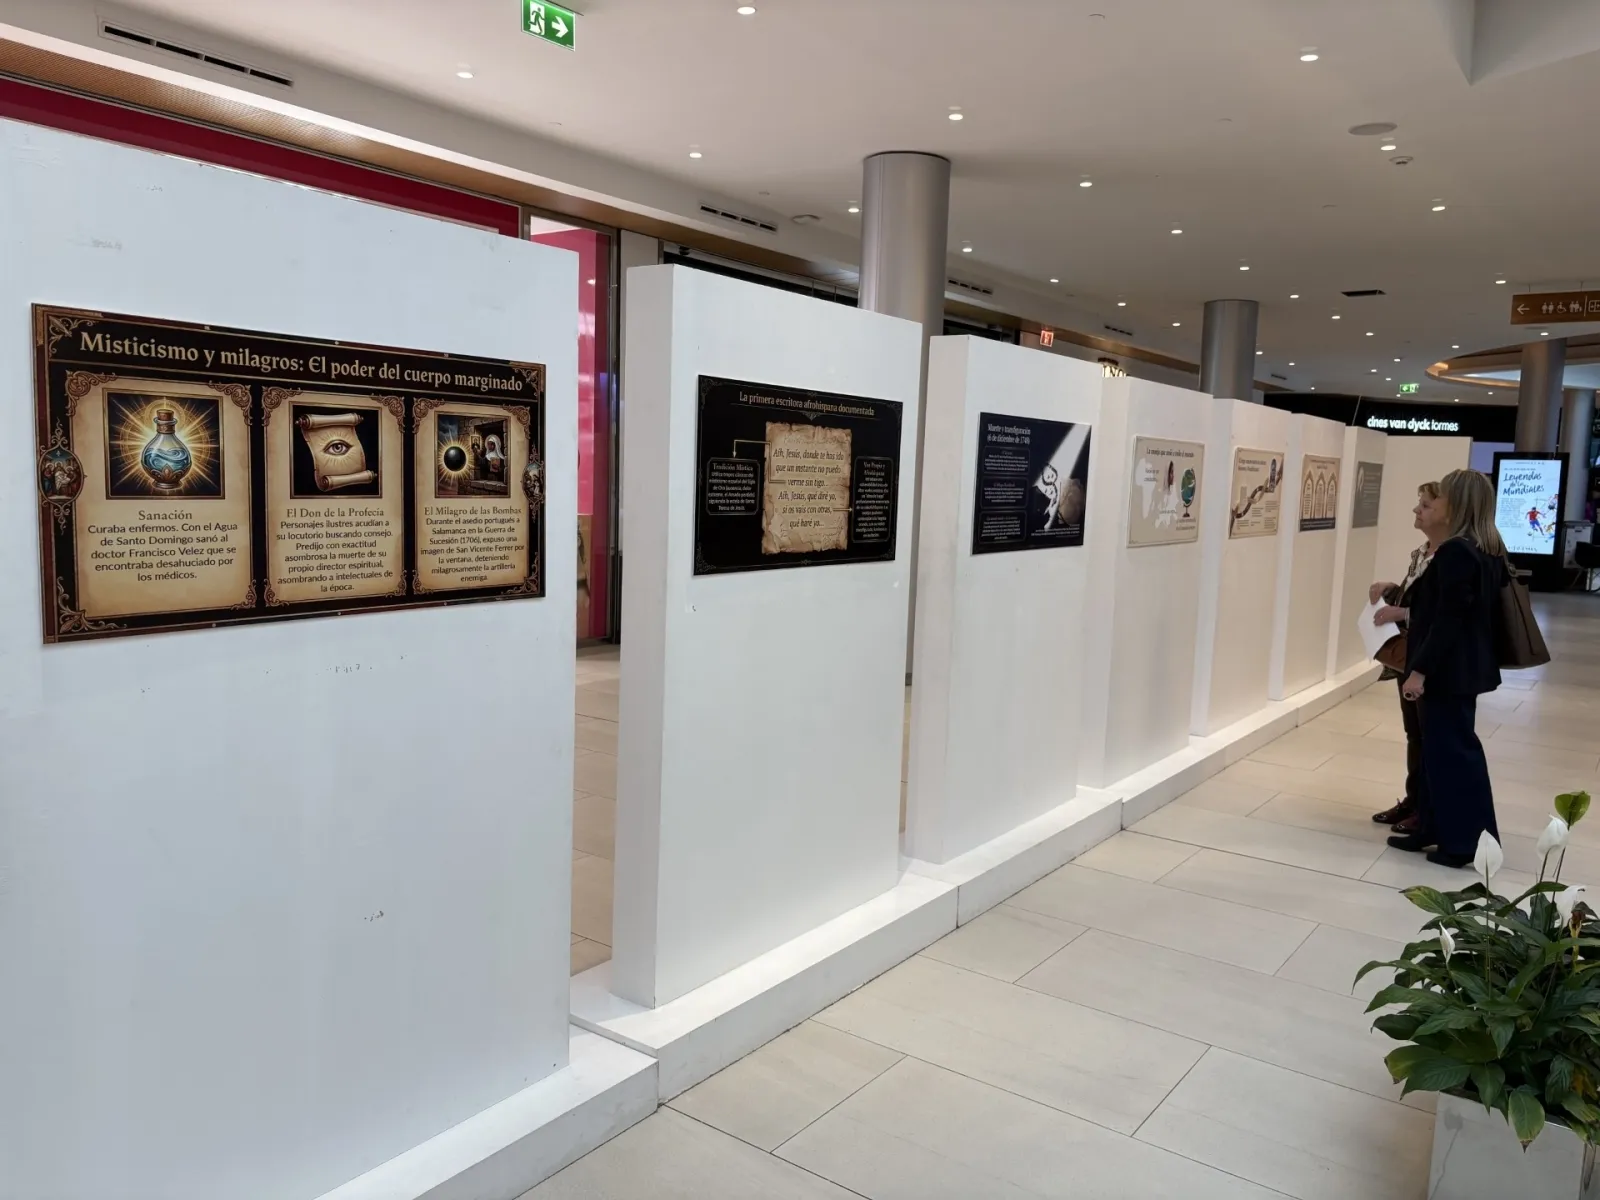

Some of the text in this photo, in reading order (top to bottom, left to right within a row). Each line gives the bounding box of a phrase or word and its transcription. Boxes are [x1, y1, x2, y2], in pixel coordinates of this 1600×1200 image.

[79, 331, 524, 391] Misticismo y milagros: El poder del cuerpo marginado
[739, 391, 874, 416] La primera escritora afrohispana documentada
[1367, 416, 1388, 428] cines
[1389, 419, 1406, 429] van
[1408, 418, 1430, 432] dyck
[776, 465, 786, 473] que
[826, 465, 841, 475] puedo
[805, 478, 813, 486] sin
[1503, 471, 1542, 483] Leyendas
[1503, 484, 1544, 496] Mundiales
[138, 509, 193, 521] Sanación
[286, 507, 384, 518] El Don de la Profecía
[424, 507, 433, 515] El
[435, 507, 468, 517] Milagro
[280, 520, 324, 530] Personajes
[326, 520, 353, 528] ilustres
[484, 517, 515, 525] portugués
[88, 522, 238, 534] Curaba enfermos. Con el Agua
[100, 534, 228, 546] de Santo Domingo sanó al
[288, 531, 324, 540] locutorio
[326, 530, 362, 539] buscando
[364, 530, 394, 538] consejo.
[296, 542, 324, 551] Predijo
[342, 540, 377, 549] exactitud
[91, 549, 126, 559] doctor
[129, 548, 176, 558] Francisco
[178, 546, 204, 556] Velez
[207, 547, 224, 556] que
[284, 553, 328, 562] asombrosa
[474, 554, 510, 562] deteniendo
[95, 558, 234, 572] encontraba desahuciado por
[288, 560, 384, 574] propio director espiritual,
[432, 566, 483, 574] milagrosamente
[137, 571, 198, 582] los médicos.
[278, 574, 328, 584] asombrando
[336, 571, 382, 580] intelectuales
[329, 584, 355, 592] época.
